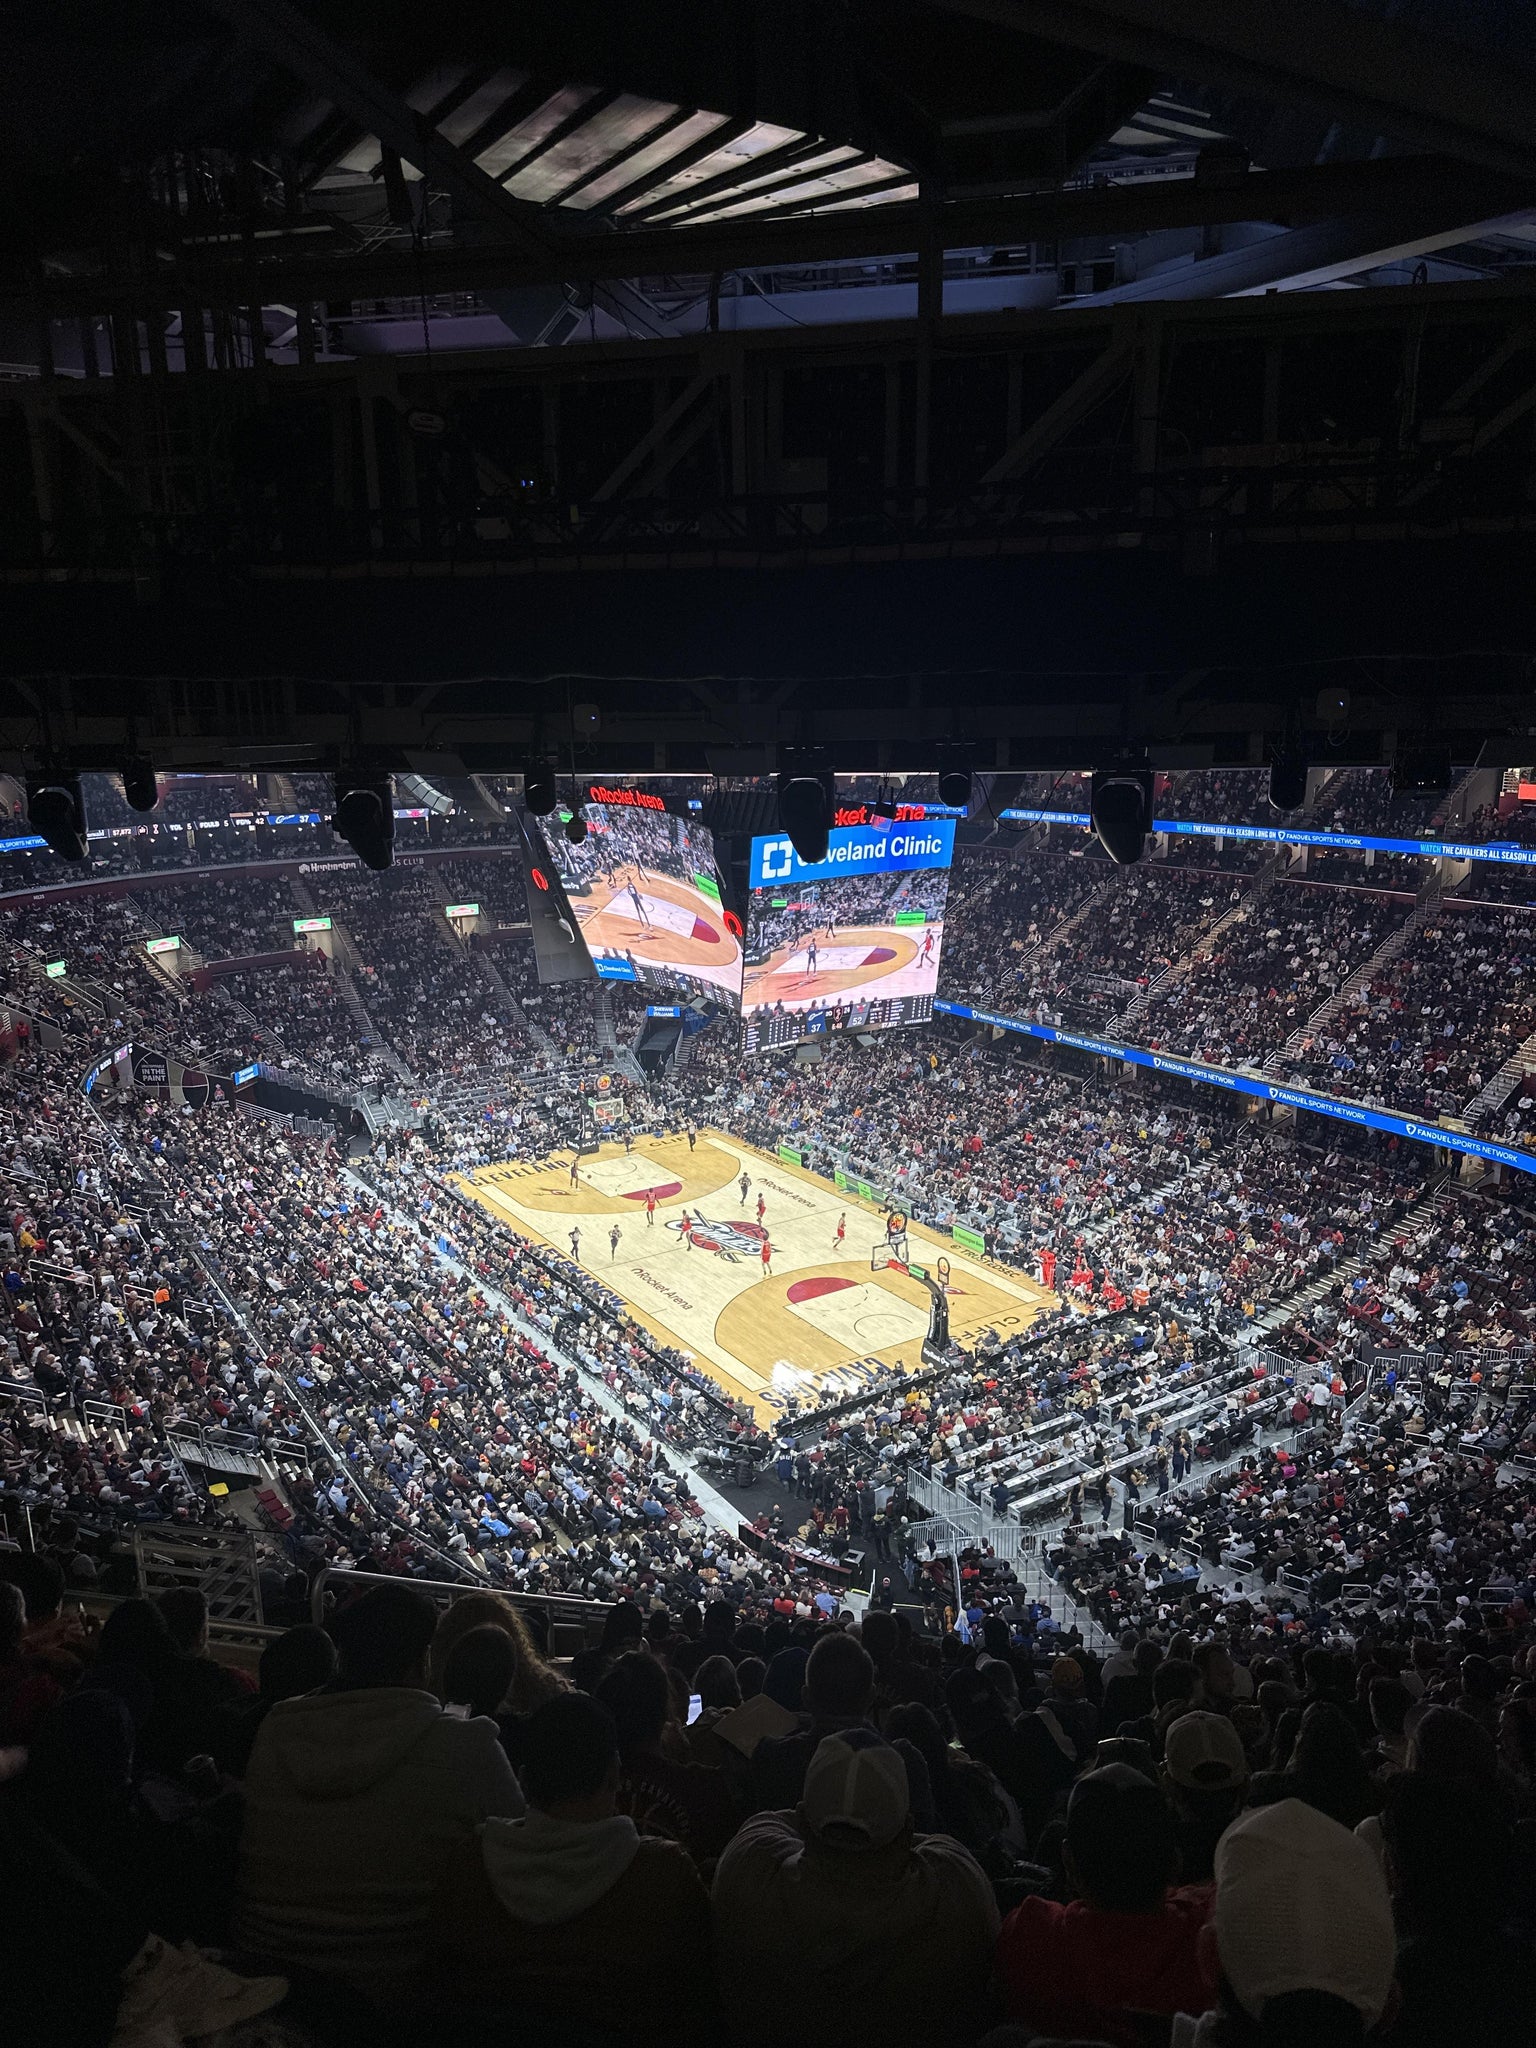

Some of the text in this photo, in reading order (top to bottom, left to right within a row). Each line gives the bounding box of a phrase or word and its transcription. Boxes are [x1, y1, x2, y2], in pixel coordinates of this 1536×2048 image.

[598, 786, 665, 812] Rocket Arena
[300, 815, 309, 823] 37
[1202, 826, 1226, 835] CAVALIERS
[1227, 828, 1235, 836] ALL
[1236, 828, 1255, 837] SEASON
[1287, 834, 1311, 842] FANDUEL
[1312, 835, 1333, 843] SPORTS
[1334, 837, 1361, 845] NETWORK
[797, 835, 942, 866] veland Clinic
[1420, 844, 1440, 854] WATCH
[1442, 845, 1453, 854] THE
[1454, 847, 1488, 858] CAVALIERS
[1488, 850, 1500, 859] ALL
[1502, 851, 1527, 861] SEASON
[811, 1023, 821, 1032] 37
[852, 1017, 862, 1025] 52
[997, 1017, 1011, 1026] SPORTS
[1011, 1021, 1032, 1032] NETWORK
[1084, 1041, 1101, 1050] SPORTS
[1101, 1045, 1125, 1056] NETWORK
[1161, 1061, 1236, 1086] FANDUEL SPORTS NETWORK
[1278, 1091, 1366, 1120] FANDUEL SPORTS NETWORK
[1418, 1129, 1518, 1162] FANDUEL SPORTS NETWORK
[467, 1159, 570, 1187] CLEVELAND
[766, 1180, 794, 1200] Rocket
[639, 1272, 693, 1310] Rocket Arena
